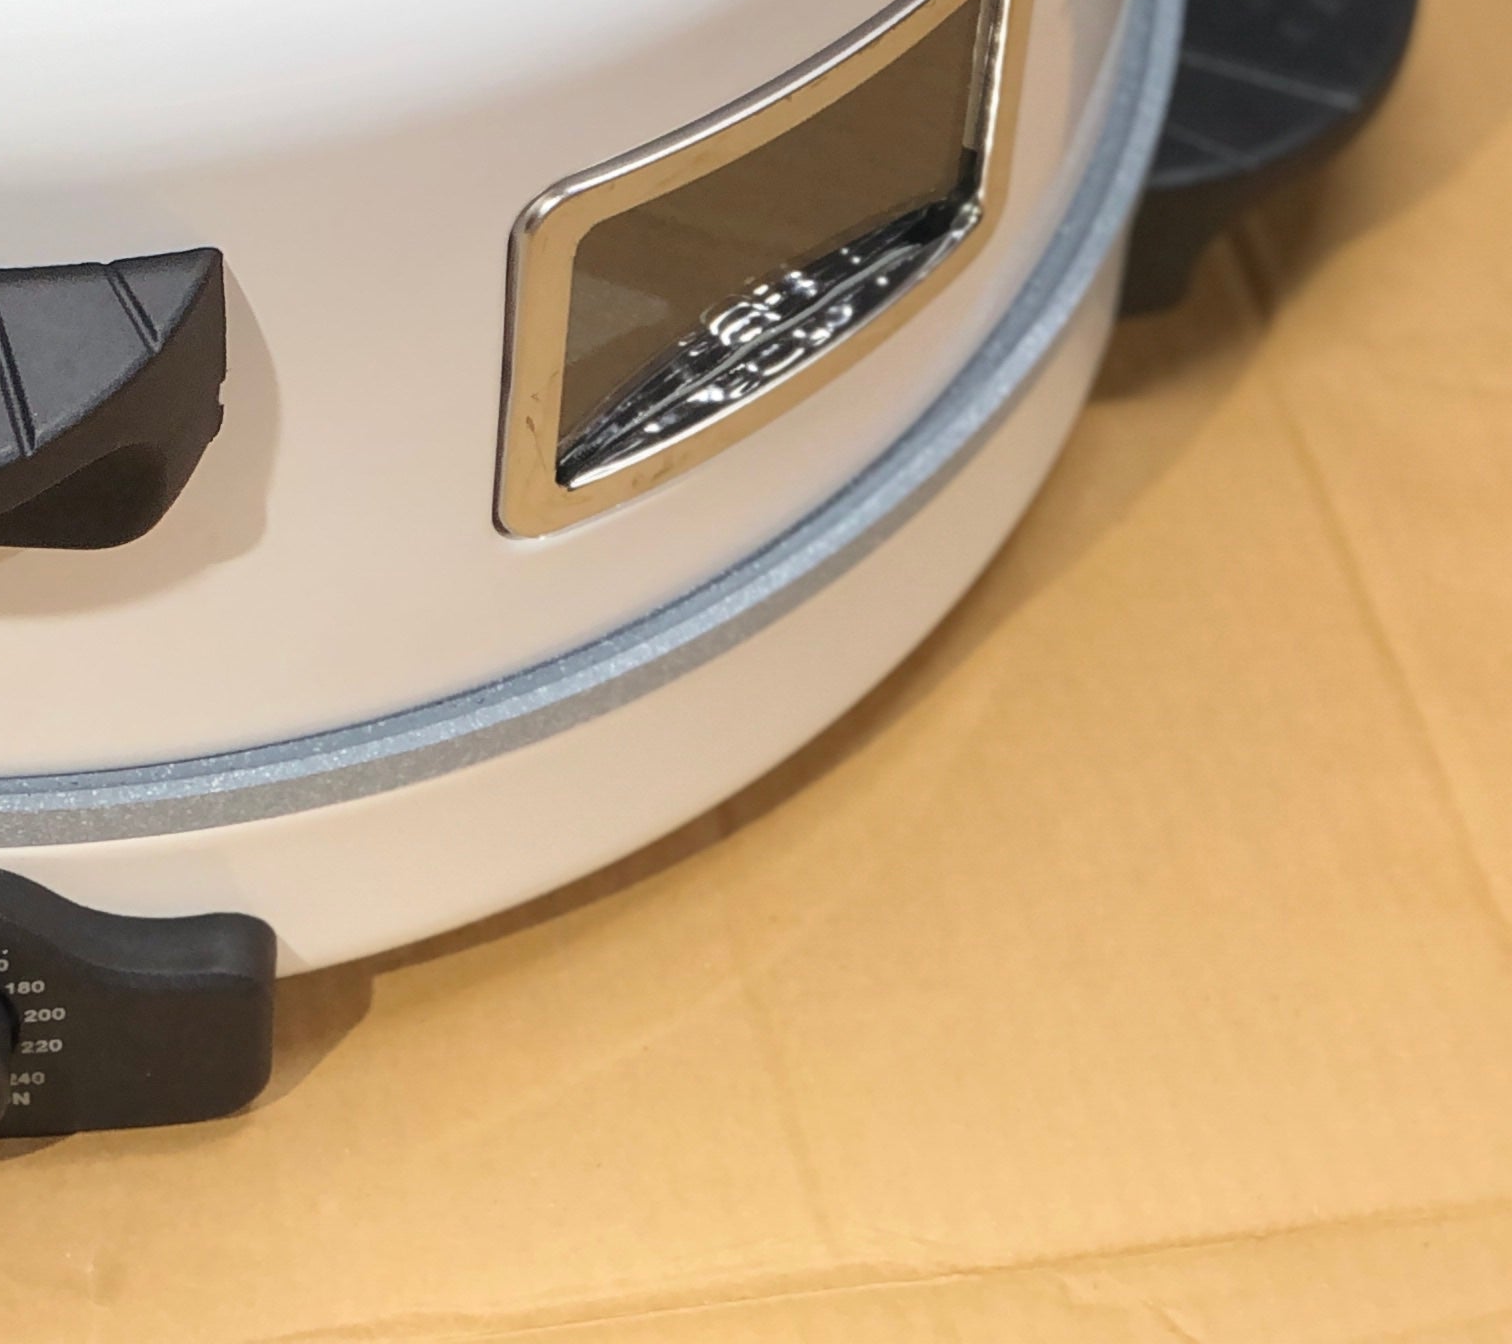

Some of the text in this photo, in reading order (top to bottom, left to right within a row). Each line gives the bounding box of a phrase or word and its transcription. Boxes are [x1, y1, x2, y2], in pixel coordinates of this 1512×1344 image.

[4, 980, 45, 995] 180
[23, 1007, 66, 1023] 200
[21, 1038, 63, 1054] 220
